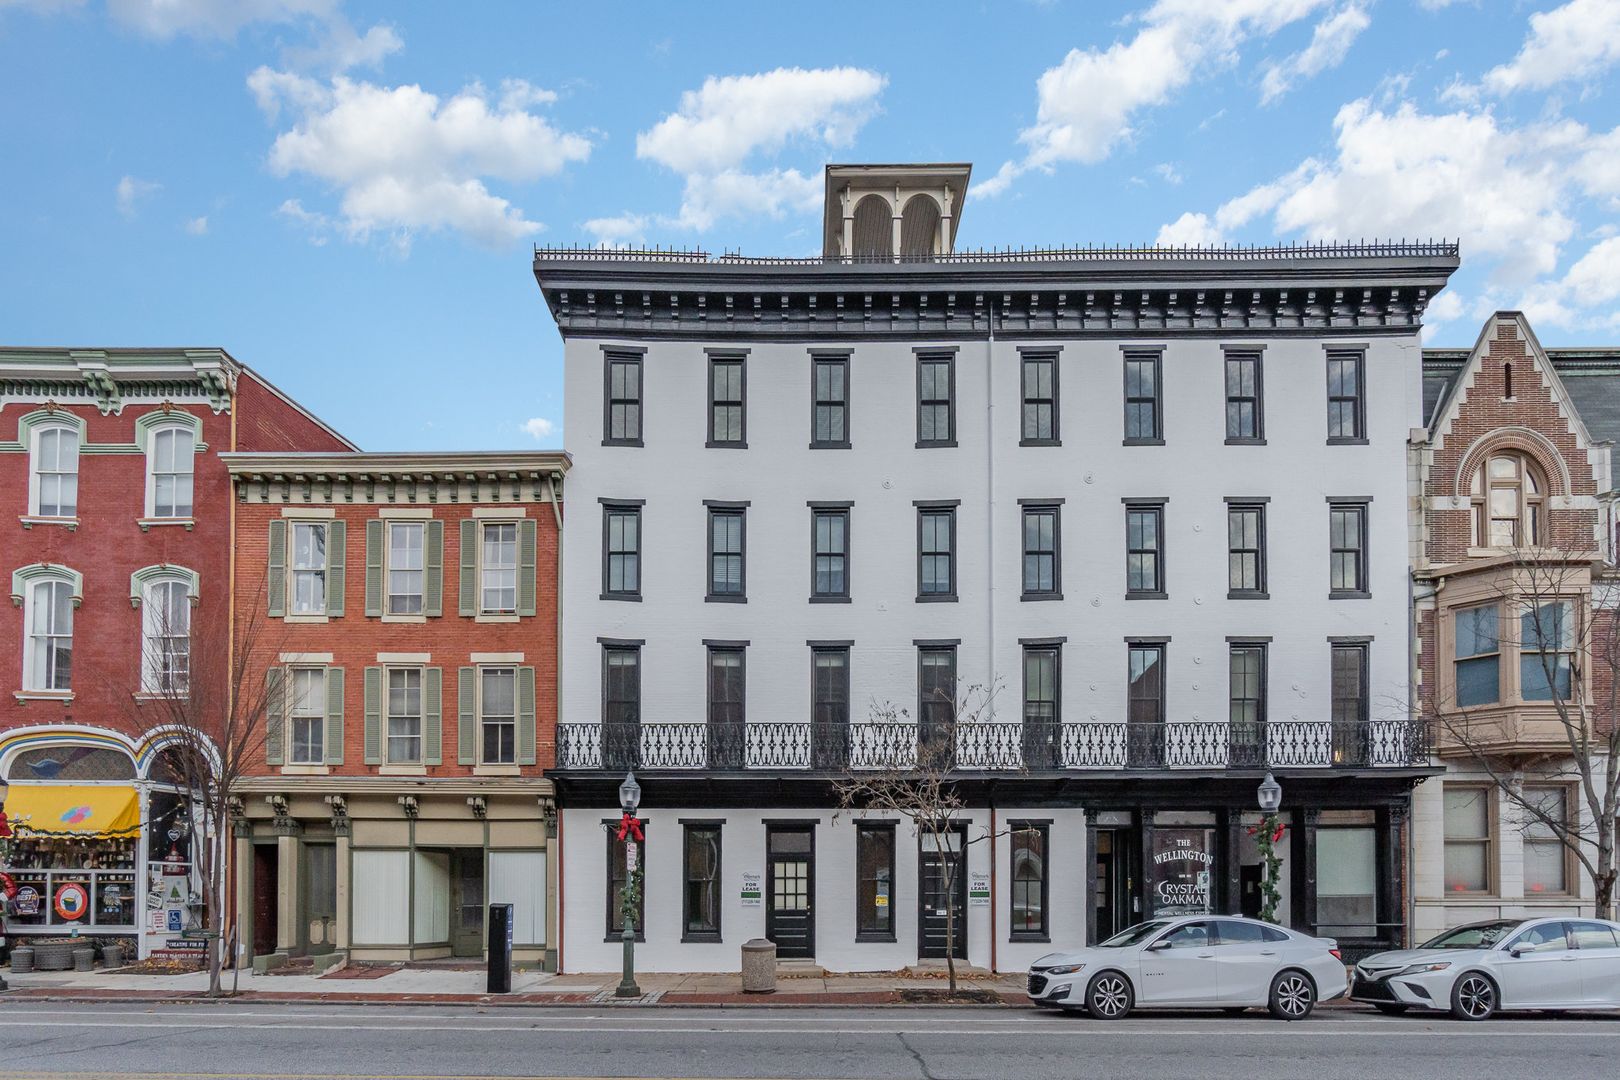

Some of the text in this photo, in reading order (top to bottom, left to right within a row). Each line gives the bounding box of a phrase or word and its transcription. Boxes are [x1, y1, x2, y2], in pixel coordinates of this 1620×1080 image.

[1154, 850, 1213, 865] WELLINGTON
[1158, 880, 1207, 897] CRYSTAL
[1162, 894, 1209, 905] OAKMAN
